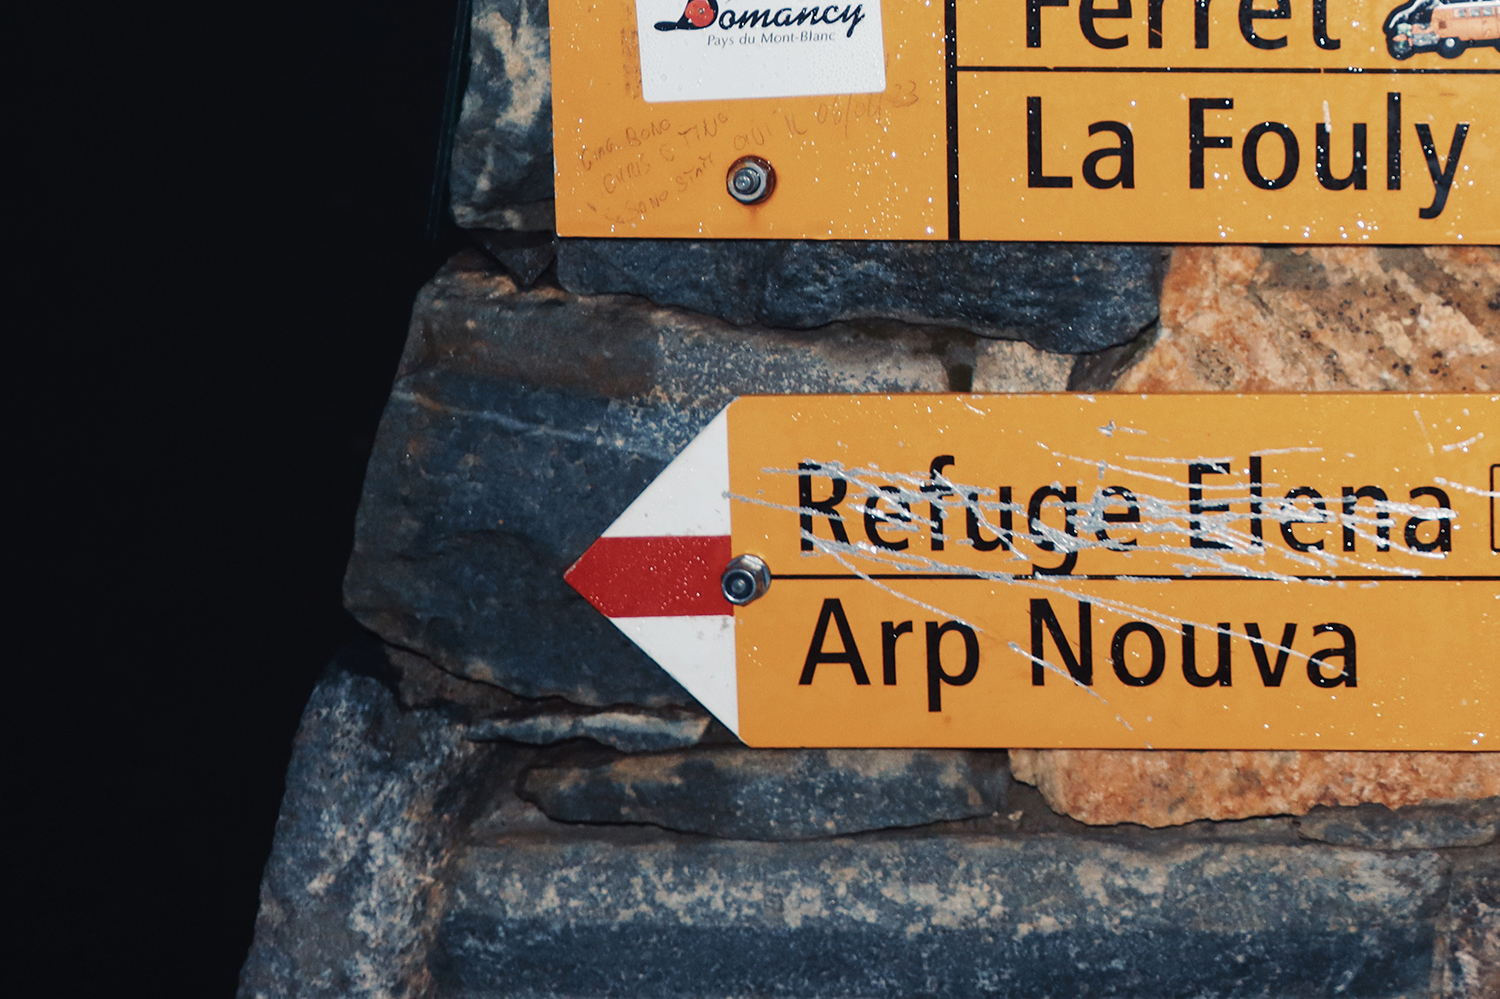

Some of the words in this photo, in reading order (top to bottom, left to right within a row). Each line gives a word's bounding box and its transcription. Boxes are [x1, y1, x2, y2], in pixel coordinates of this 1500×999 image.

[706, 34, 735, 49] Pays
[738, 32, 756, 45] du
[760, 30, 836, 45] Mont-Blanc
[1026, 95, 1136, 190] La
[1187, 91, 1471, 220] Fouly
[798, 454, 1142, 576] Refuge
[1188, 455, 1453, 554] Elena
[798, 598, 980, 713] Arp
[1027, 597, 1360, 689] Nouva
